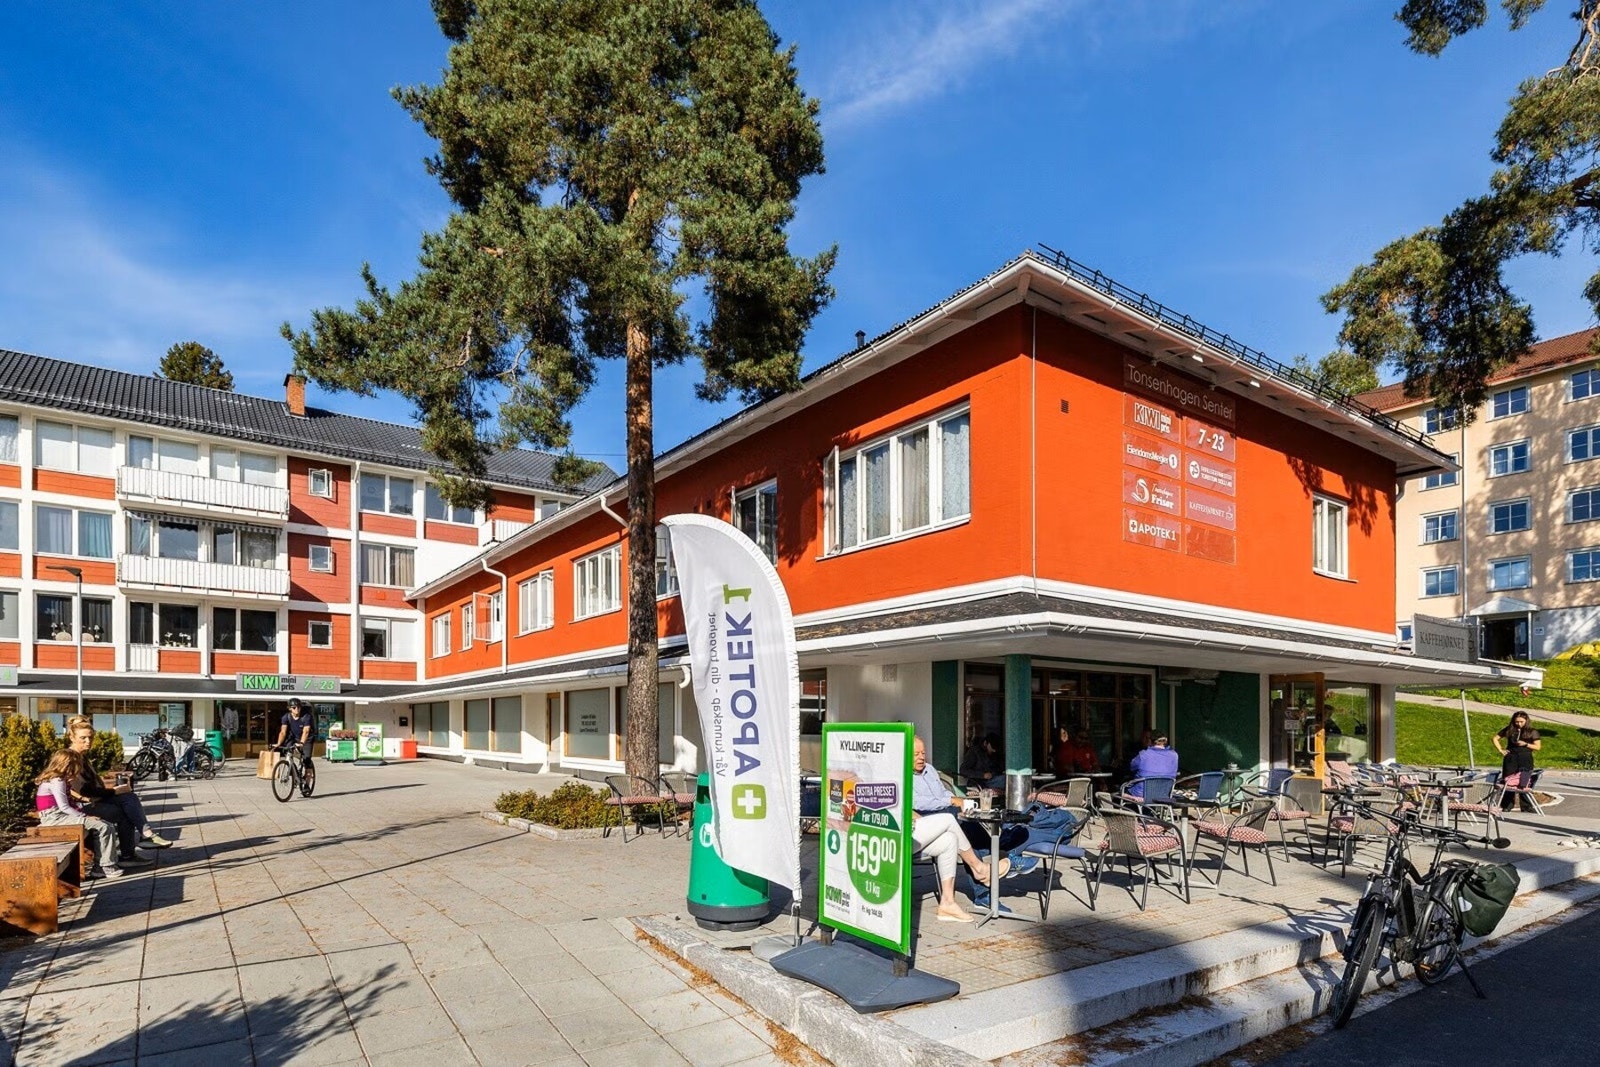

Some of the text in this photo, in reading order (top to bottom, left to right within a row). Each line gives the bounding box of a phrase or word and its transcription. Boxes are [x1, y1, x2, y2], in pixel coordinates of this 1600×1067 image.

[1128, 364, 1233, 420] Tonsenhagen Senter
[1134, 402, 1161, 430] KIWI
[1198, 428, 1206, 445] 7
[1212, 433, 1225, 451] 23
[1126, 444, 1169, 465] EiendomsMegler
[1138, 522, 1177, 541] APOTEK 1
[1420, 631, 1465, 650] KAFFEHJØRNET
[242, 674, 280, 690] KIWI
[281, 675, 297, 684] mini
[281, 682, 295, 691] pris
[303, 679, 312, 689] 7
[320, 680, 335, 690] 23
[840, 740, 885, 754] KYLLINGFILET
[856, 785, 895, 797] EKSTRA PRESSET
[861, 810, 889, 827] Før 179,00
[825, 884, 842, 904] KIWI
[872, 882, 880, 898] kg
